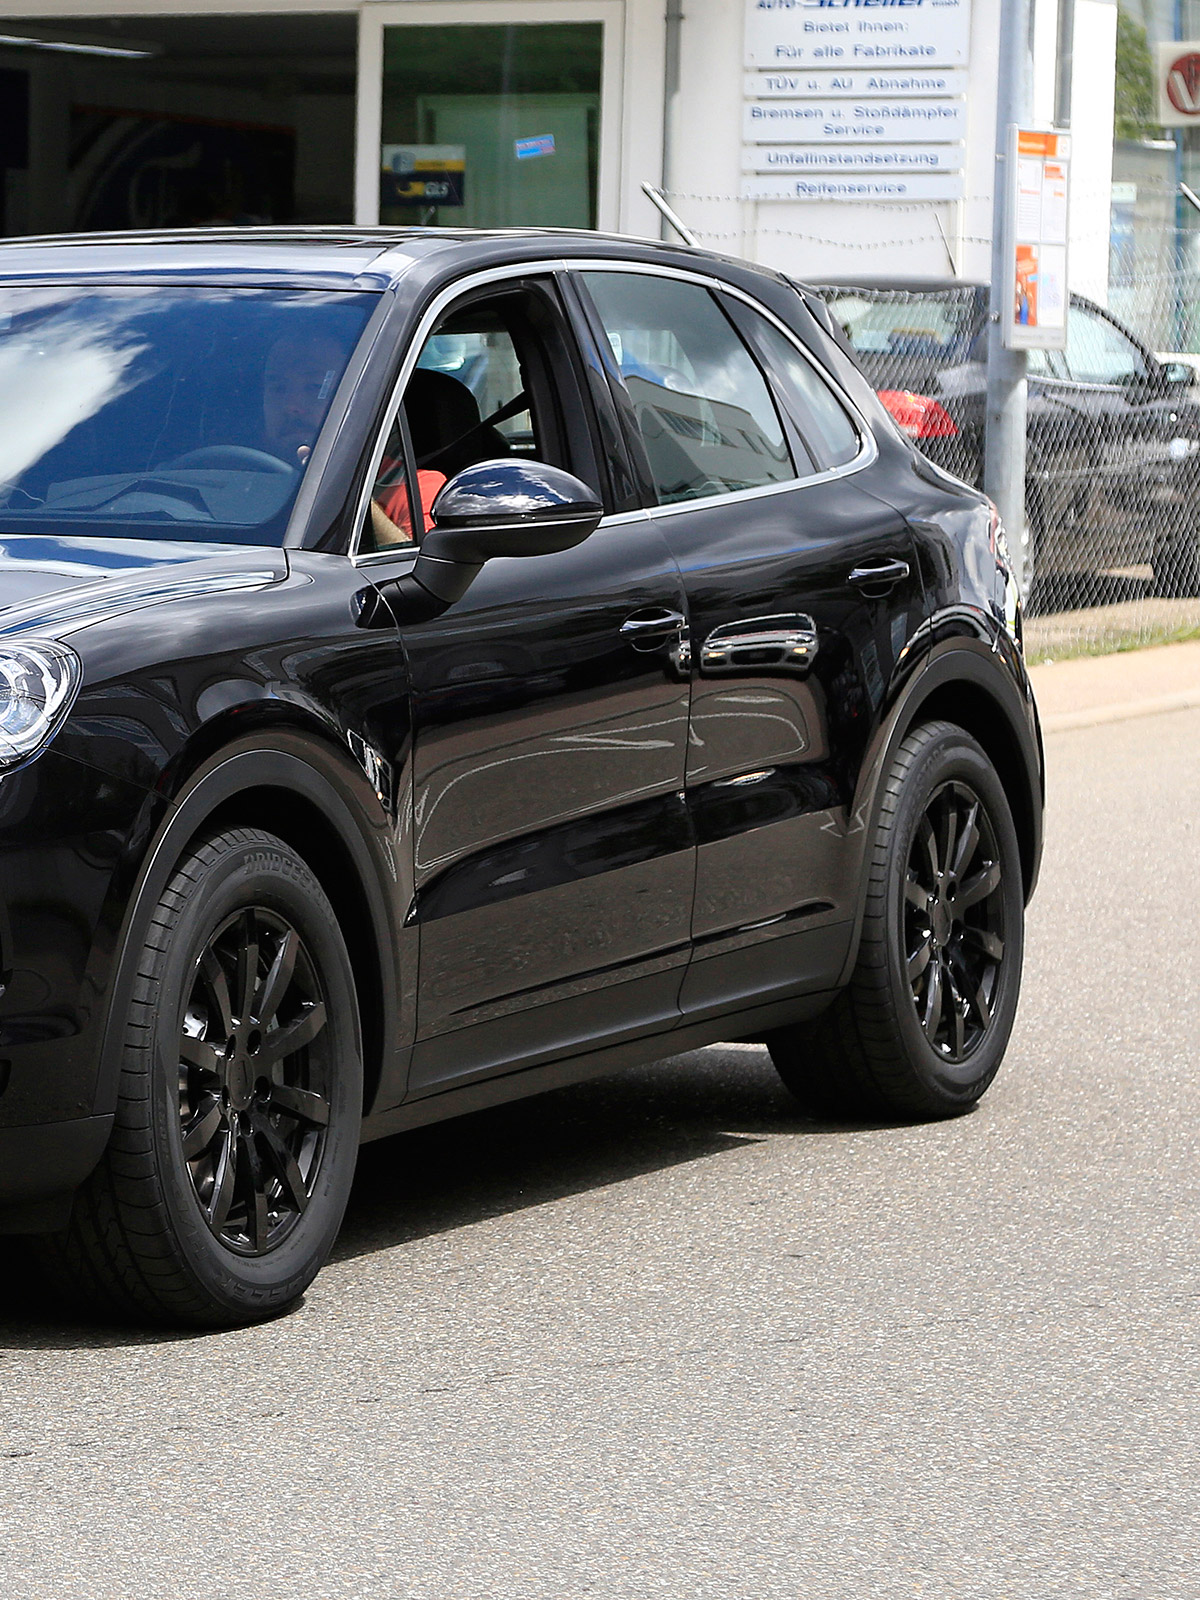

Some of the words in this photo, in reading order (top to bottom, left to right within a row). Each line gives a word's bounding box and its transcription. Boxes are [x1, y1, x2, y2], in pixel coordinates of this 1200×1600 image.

[803, 20, 850, 33] Bietet
[775, 44, 803, 58] Für
[813, 44, 845, 57] alle
[853, 43, 937, 57] Fabrikate
[765, 74, 799, 89] TÜV
[830, 77, 854, 89] AU
[867, 77, 947, 89] Abnahme
[751, 105, 824, 119] Bremsen
[853, 105, 960, 121] Stoßdämpfer
[823, 123, 886, 136] Service
[767, 150, 940, 167] Unfallinstandsetzung
[795, 180, 907, 195] Reifenservice
